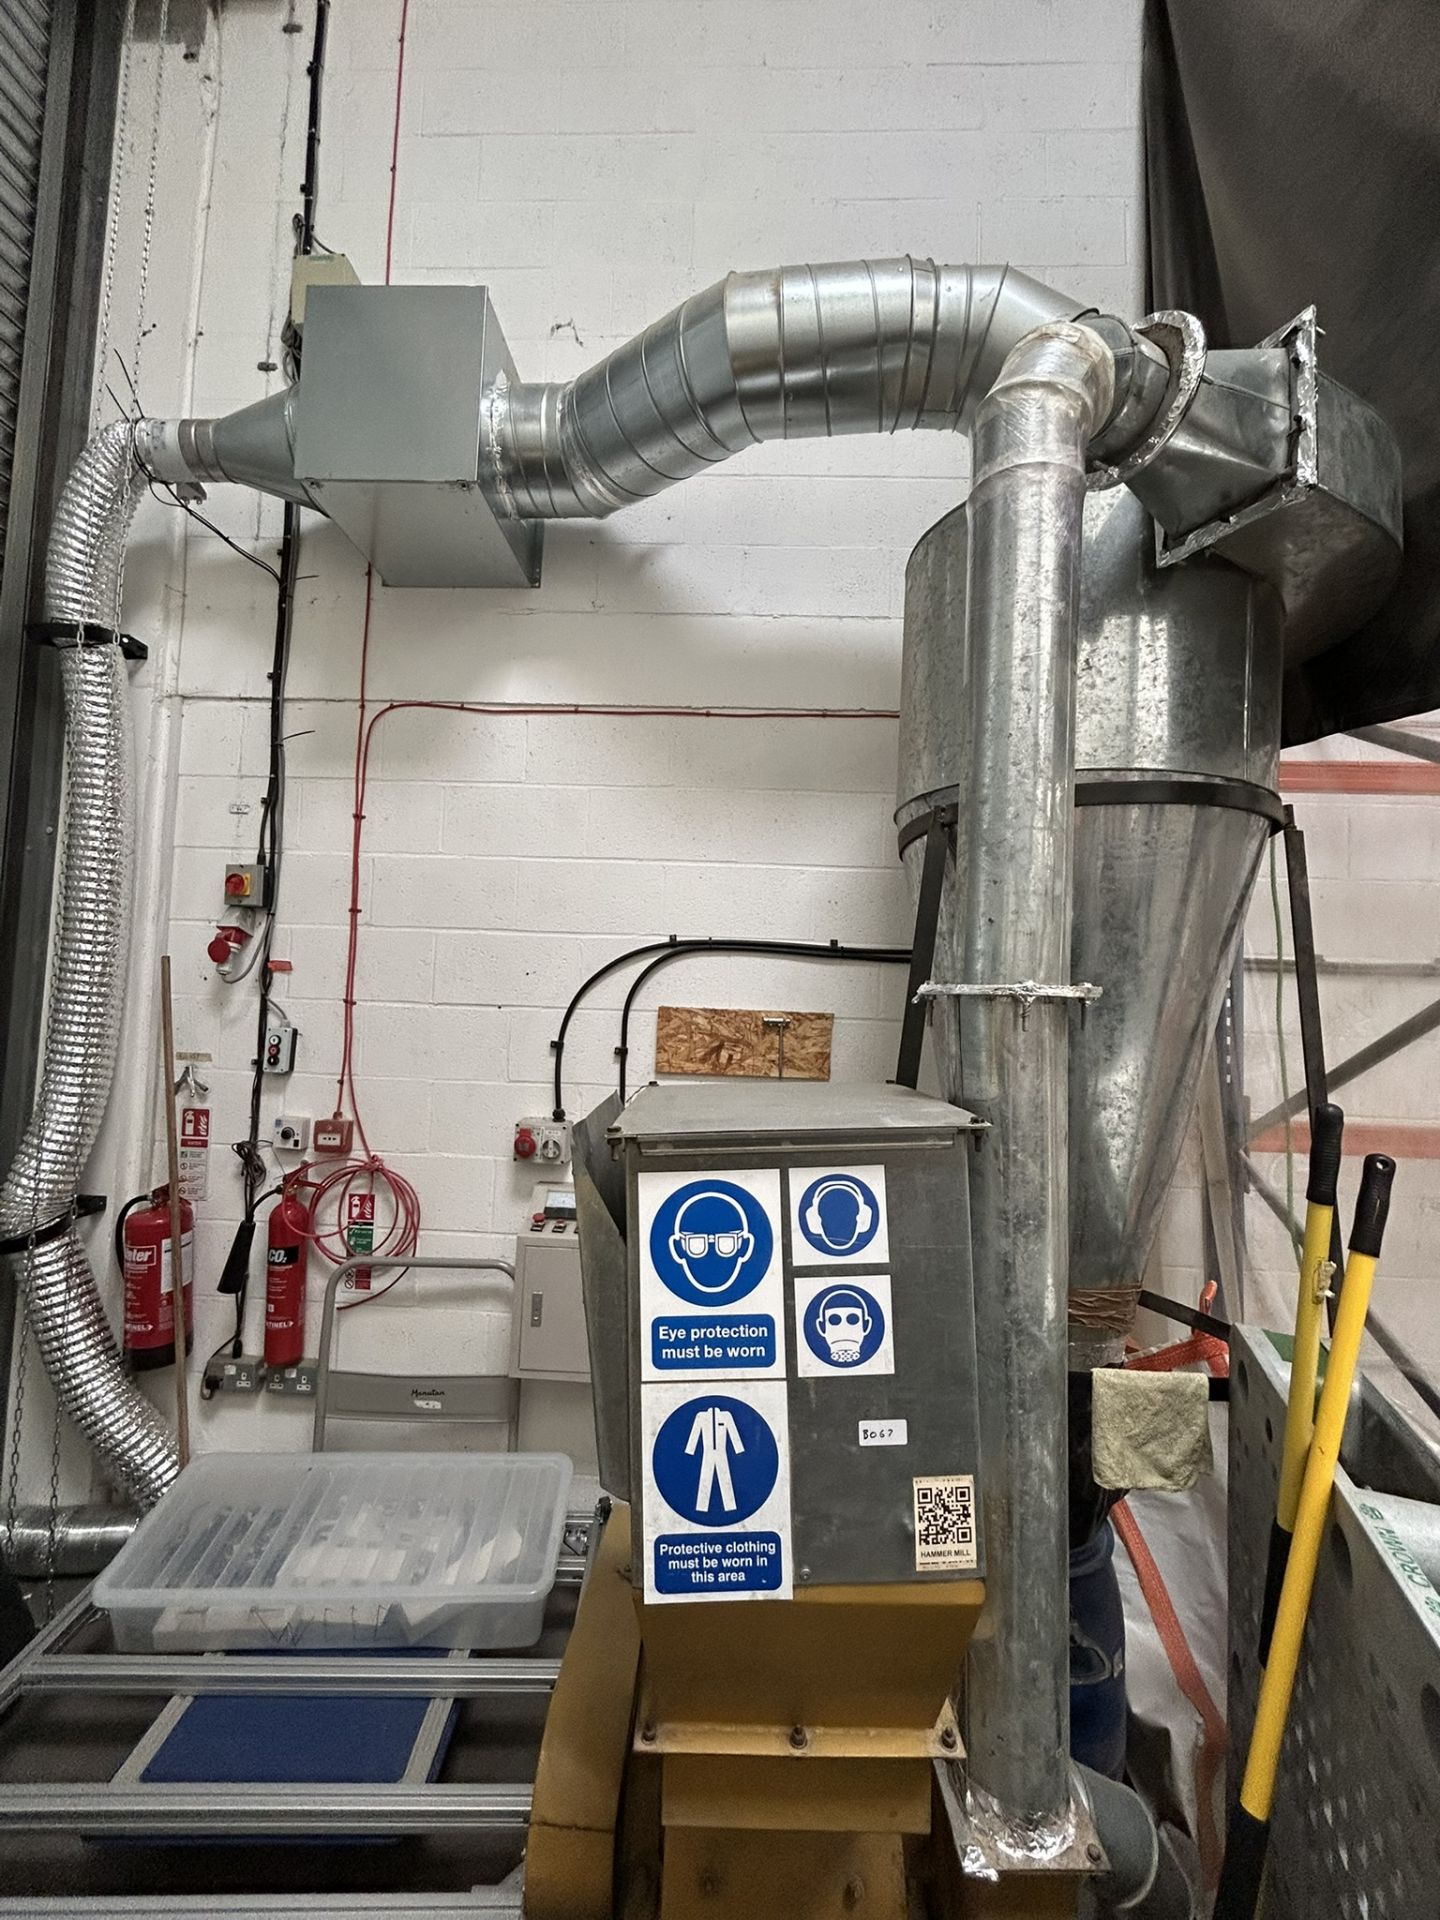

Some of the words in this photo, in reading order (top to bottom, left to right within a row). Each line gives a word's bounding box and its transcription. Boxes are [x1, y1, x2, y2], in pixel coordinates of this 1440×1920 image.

[125, 1248, 152, 1262] ater
[658, 1326, 687, 1342] Eye
[691, 1324, 768, 1341] protection
[662, 1345, 700, 1359] must
[704, 1344, 723, 1358] be
[726, 1346, 766, 1357] worn
[660, 1542, 723, 1556] Protective
[725, 1541, 776, 1555] clothing
[920, 1549, 953, 1558] HAMMER
[954, 1549, 972, 1557] MILL
[668, 1558, 700, 1570] must
[702, 1556, 719, 1569] be
[721, 1558, 753, 1568] worn
[756, 1555, 768, 1567] in
[691, 1571, 715, 1583] this
[718, 1571, 746, 1582] area
